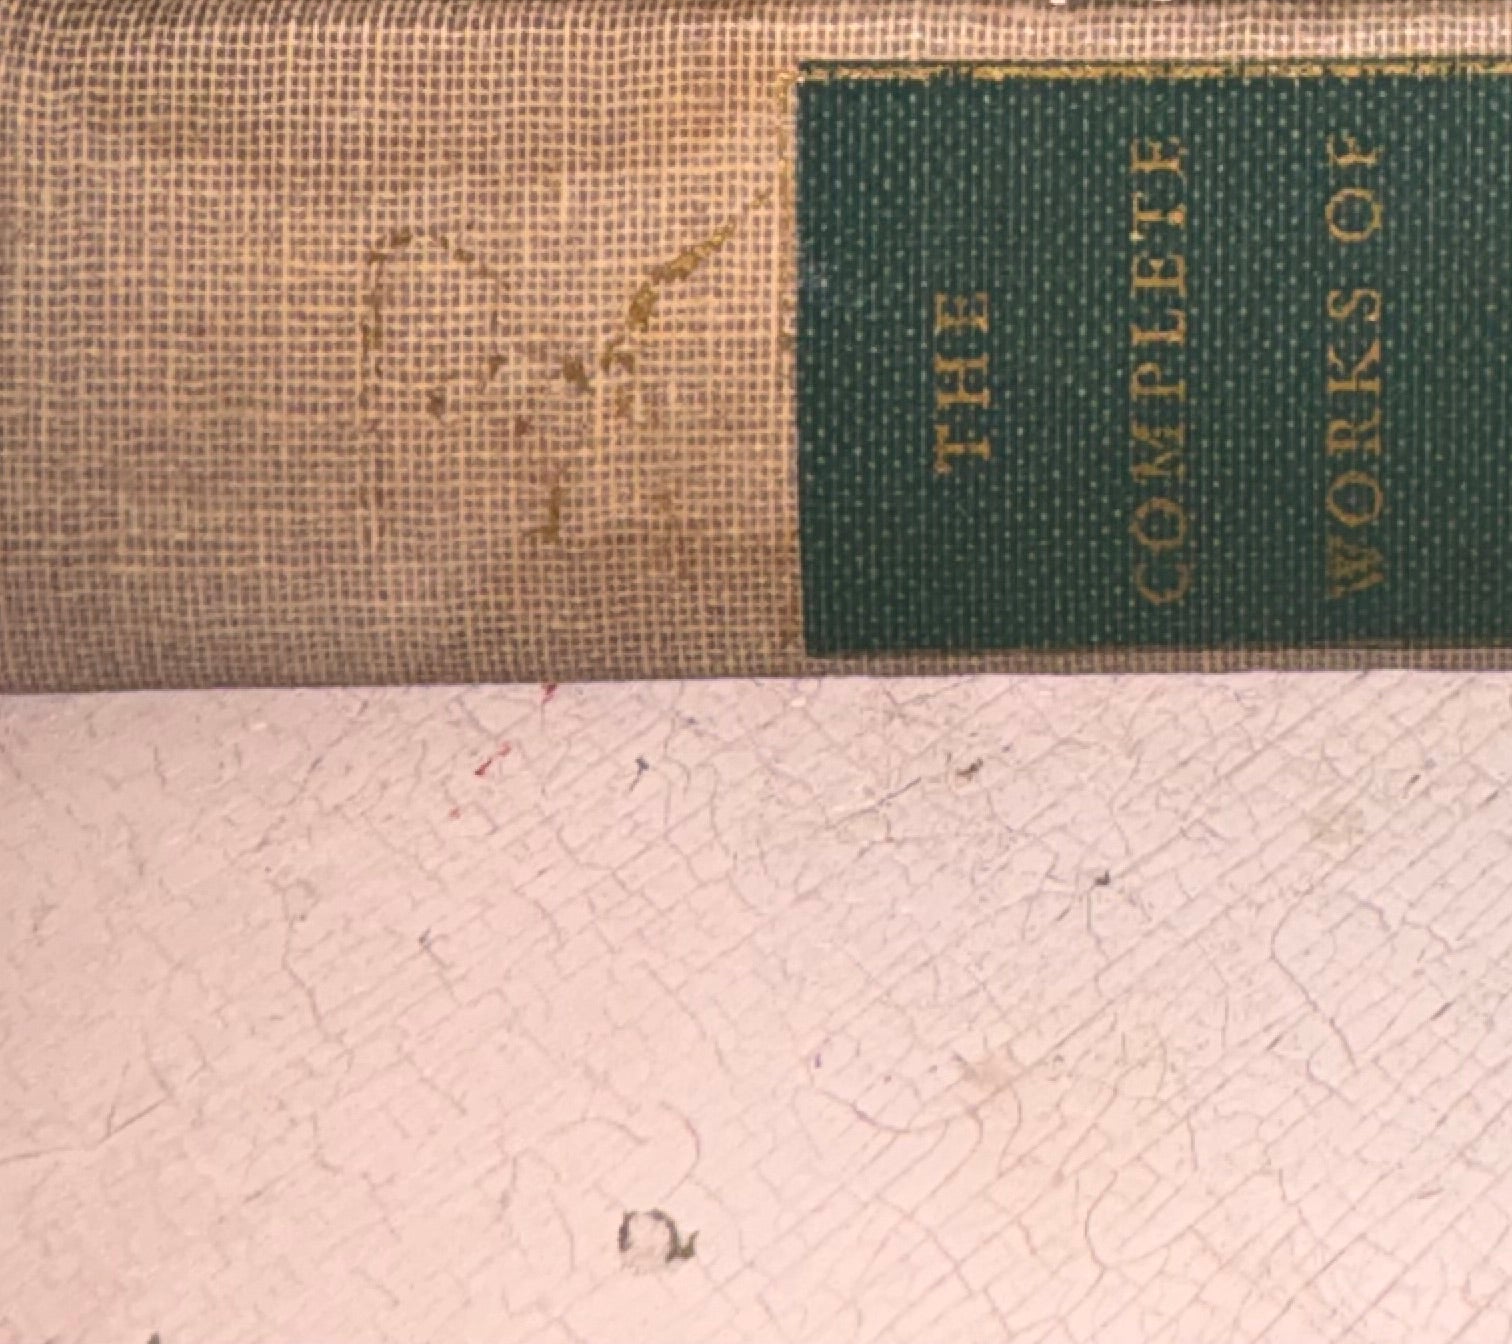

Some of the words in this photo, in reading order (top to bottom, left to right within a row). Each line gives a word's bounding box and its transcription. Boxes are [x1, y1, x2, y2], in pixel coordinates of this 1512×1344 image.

[1325, 131, 1385, 245] OF
[932, 291, 991, 476] THE
[1129, 134, 1195, 606] COMPLETE
[1325, 287, 1385, 599] WORKS
